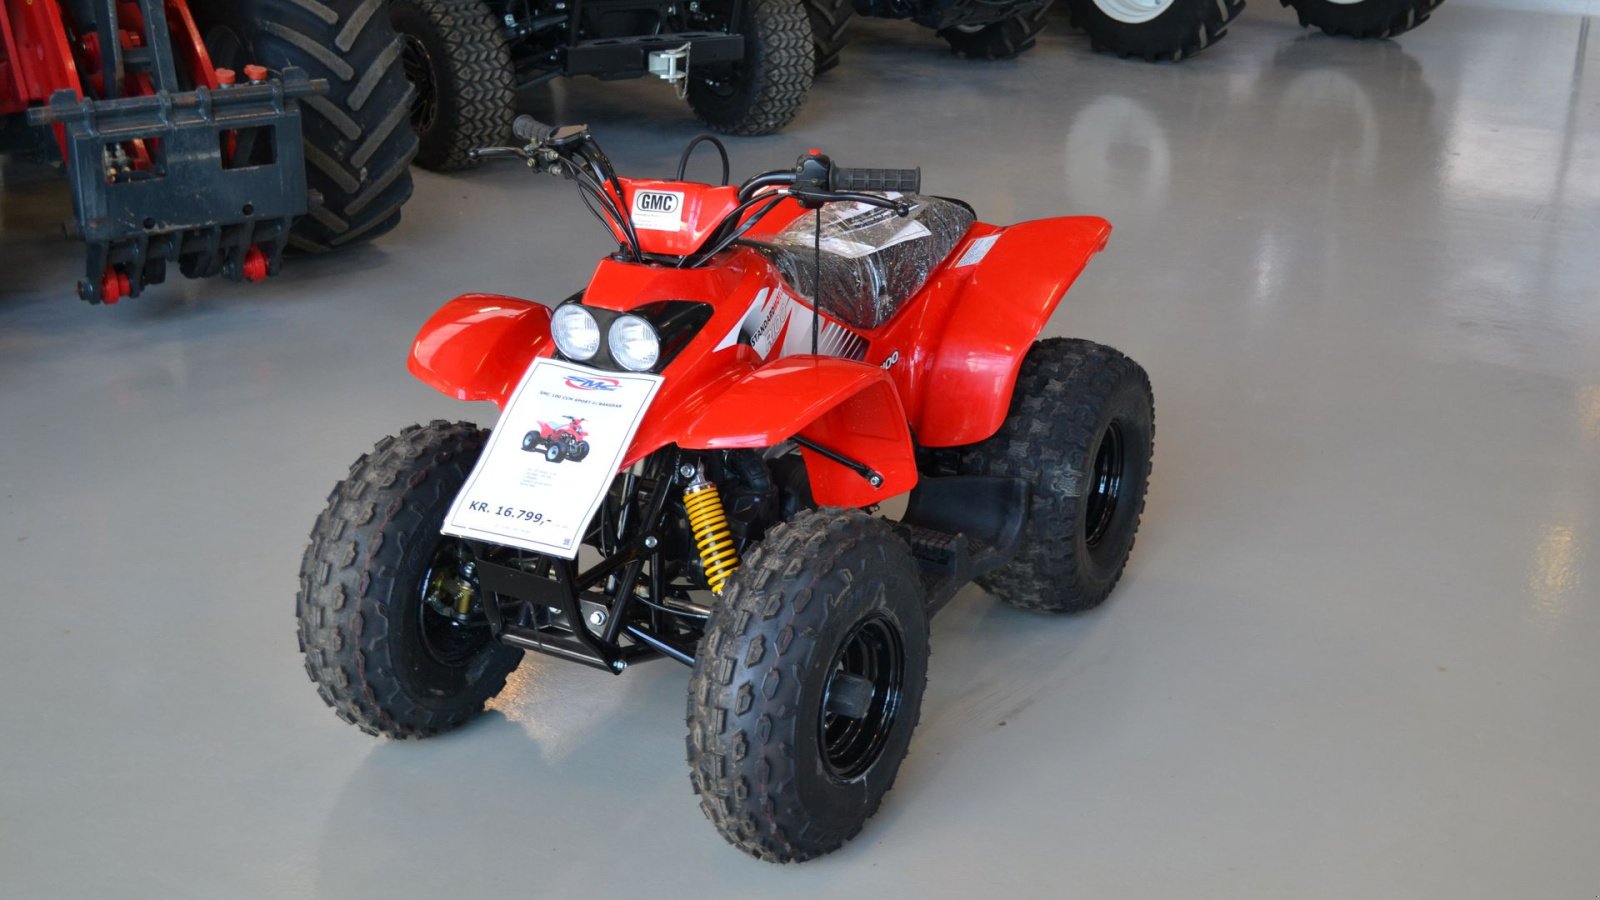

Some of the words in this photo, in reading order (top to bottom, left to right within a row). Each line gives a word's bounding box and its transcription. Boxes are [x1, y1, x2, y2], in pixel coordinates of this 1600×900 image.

[641, 193, 673, 211] GMC
[469, 500, 490, 513] KR.
[495, 506, 552, 526] 16.799,-
